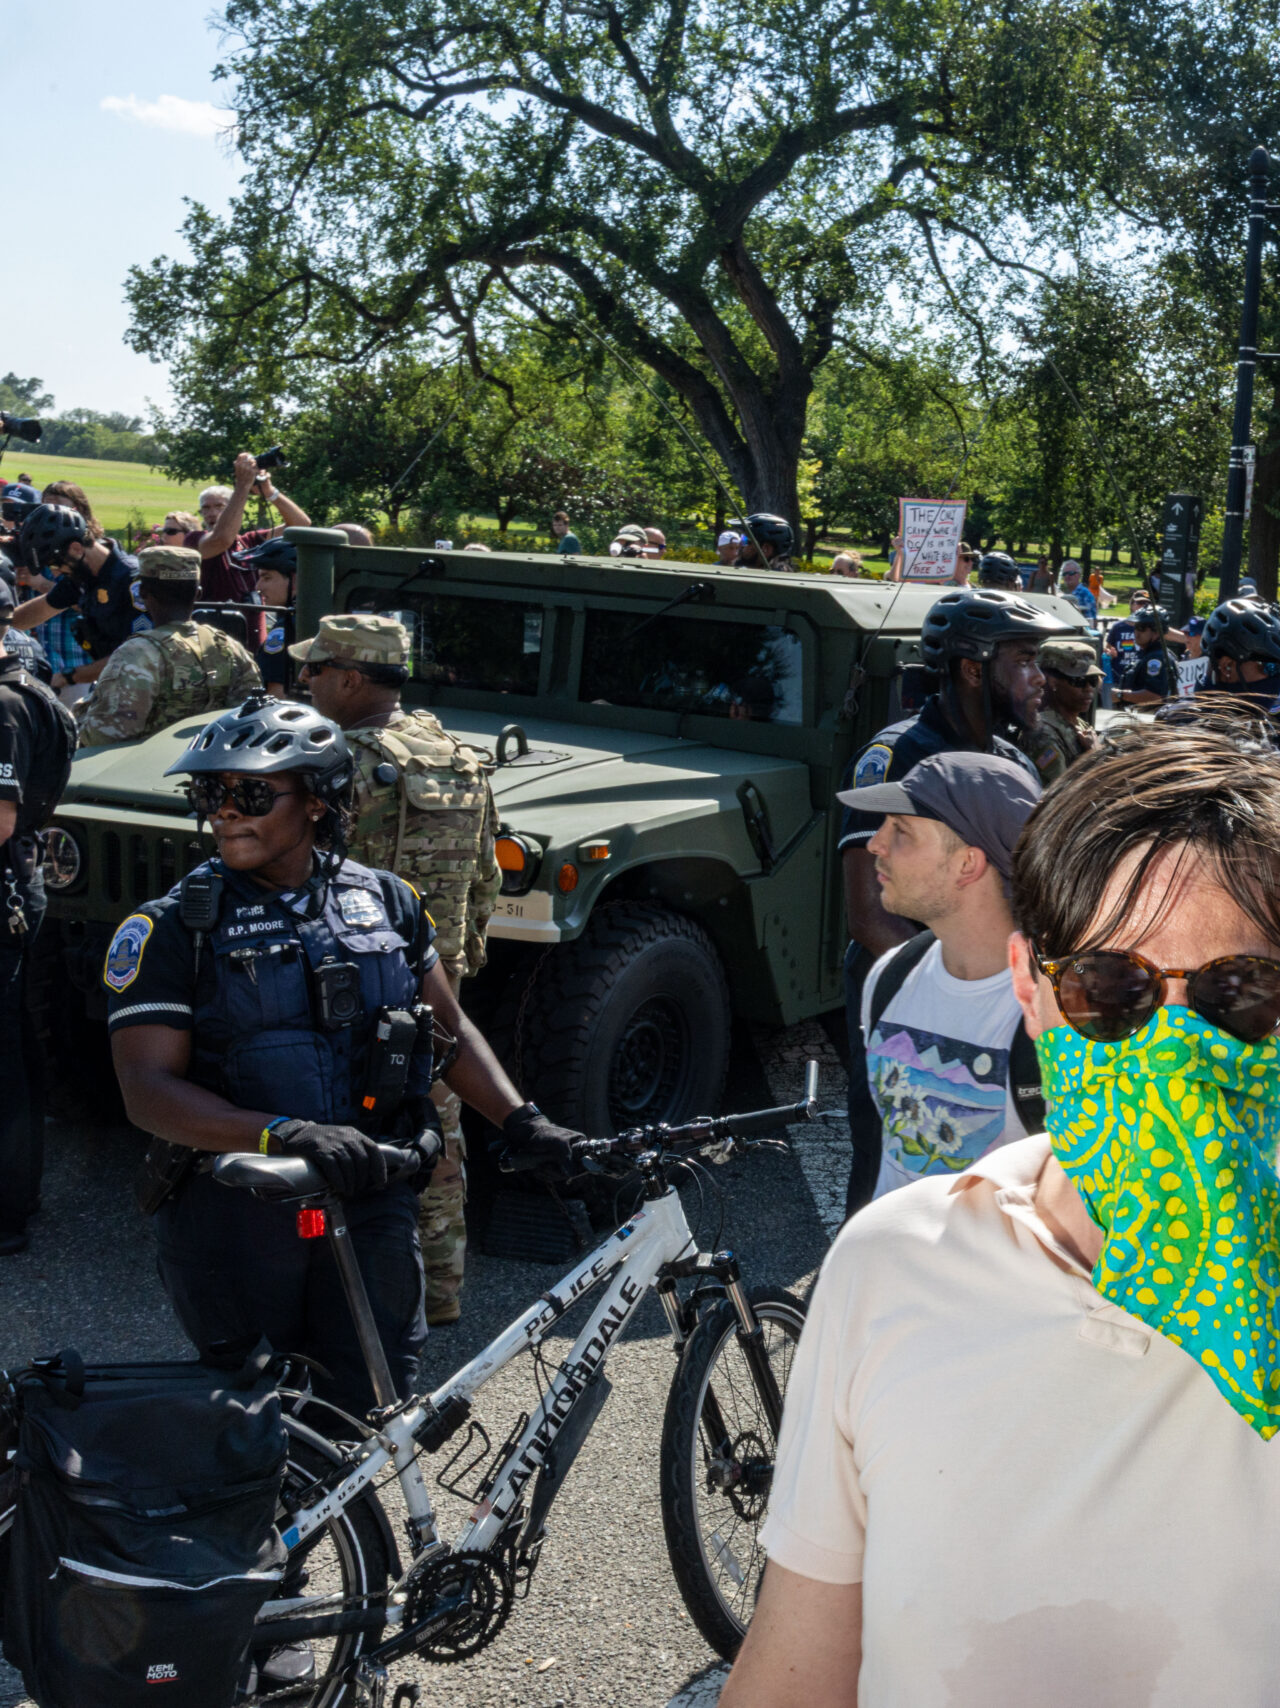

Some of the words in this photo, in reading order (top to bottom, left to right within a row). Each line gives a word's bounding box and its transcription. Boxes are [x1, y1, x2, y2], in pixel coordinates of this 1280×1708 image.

[228, 925, 248, 936] R.P.
[250, 920, 284, 933] MOORE
[316, 1505, 331, 1520] IN
[338, 1475, 366, 1501] USA
[146, 1670, 178, 1679] MOTO
[148, 1663, 175, 1673] KEMI
